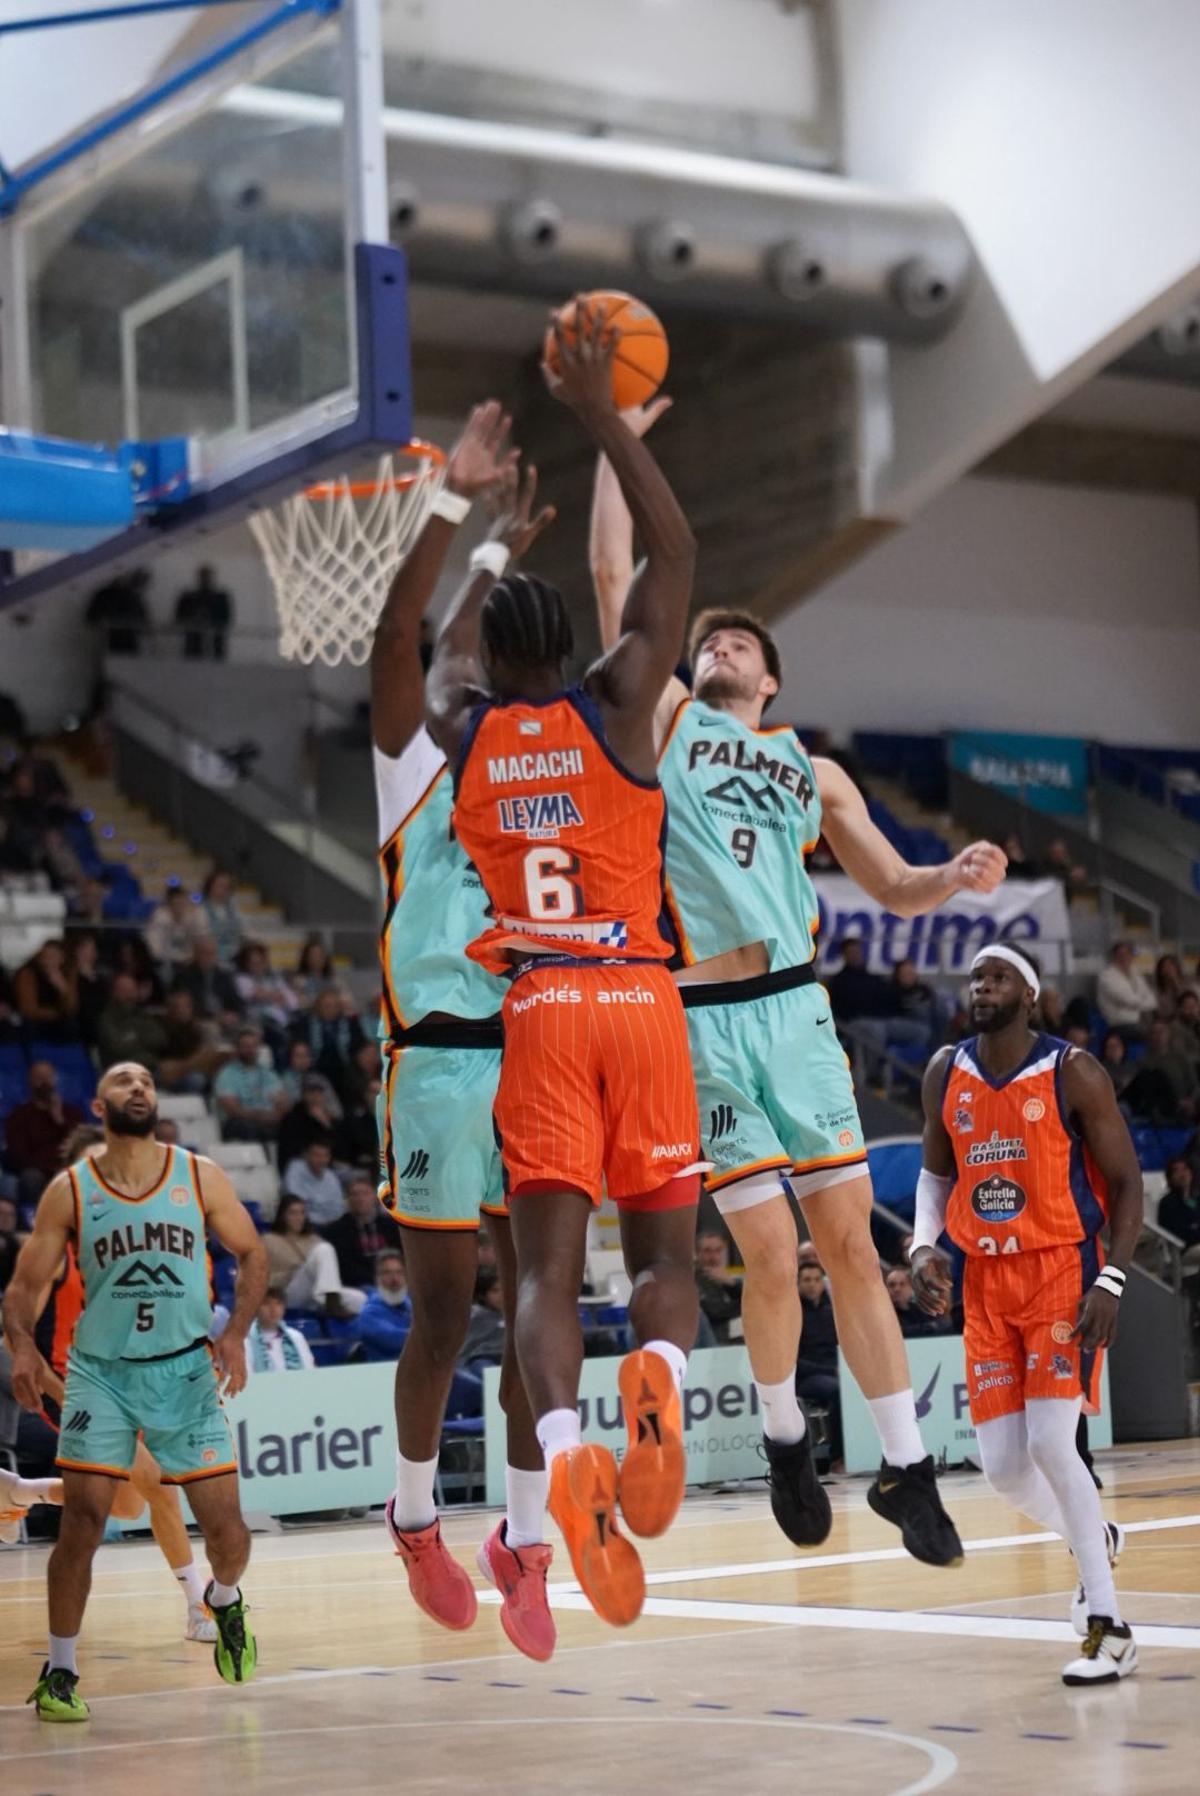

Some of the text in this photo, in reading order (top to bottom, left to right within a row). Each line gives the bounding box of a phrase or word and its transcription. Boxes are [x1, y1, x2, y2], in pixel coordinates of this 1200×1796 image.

[488, 749, 584, 785] MACACHI
[688, 740, 815, 813] PALMER
[499, 793, 584, 832] LEYMA
[731, 828, 757, 869] 9
[523, 846, 583, 920] 6
[512, 984, 656, 1017] Nordés ancín
[978, 1187, 1017, 1199] Estrella
[979, 1199, 1015, 1211] Galicia
[93, 1221, 196, 1270] PALMER
[136, 1302, 156, 1333] 5
